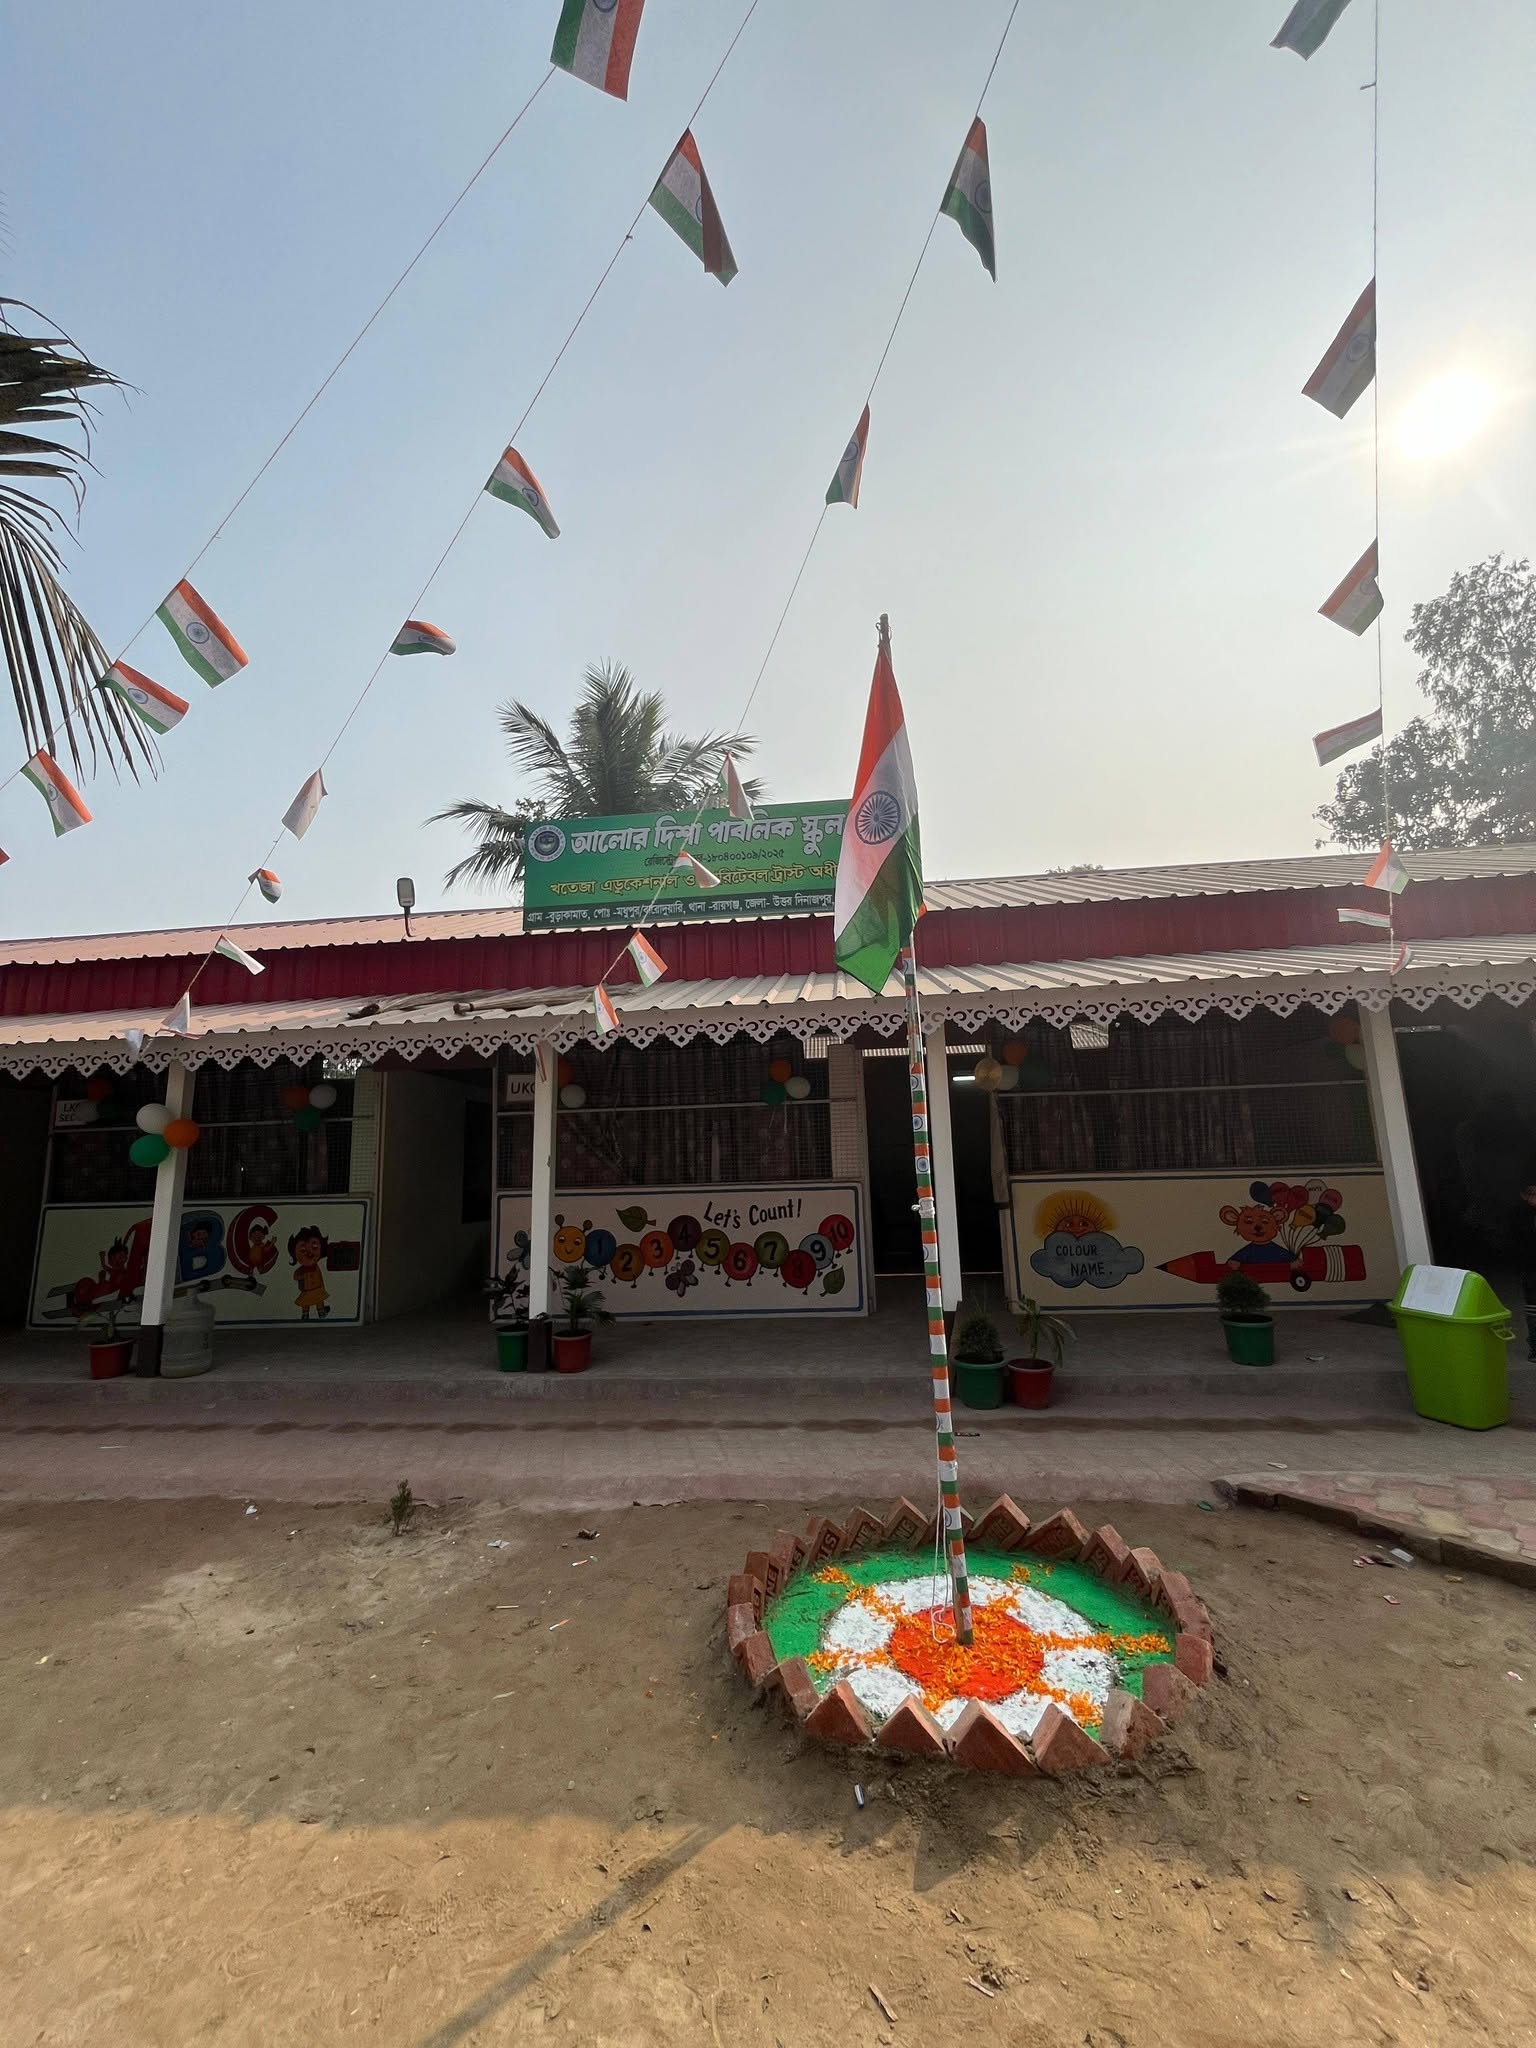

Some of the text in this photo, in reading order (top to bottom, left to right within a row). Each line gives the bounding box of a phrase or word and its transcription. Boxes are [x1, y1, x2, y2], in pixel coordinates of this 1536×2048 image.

[571, 827, 651, 854] আলোর
[653, 815, 704, 850] দিশা
[707, 808, 798, 843] পাবলিক
[801, 814, 846, 857] স্কুল
[550, 880, 597, 896] খতেজা
[600, 875, 680, 896] এডুকেশনাল
[684, 875, 696, 887] ও
[770, 864, 806, 882] ট্রাস্ট
[527, 912, 543, 922] গ্রাম
[688, 901, 706, 912] থানা
[745, 898, 770, 909] জেলা-
[772, 894, 793, 907] উত্তর
[703, 1199, 802, 1229] Let's Count!
[597, 1221, 849, 1279] 1 2 3 4 5 6 7 8 9 10
[1056, 1245, 1098, 1257] COLOUR
